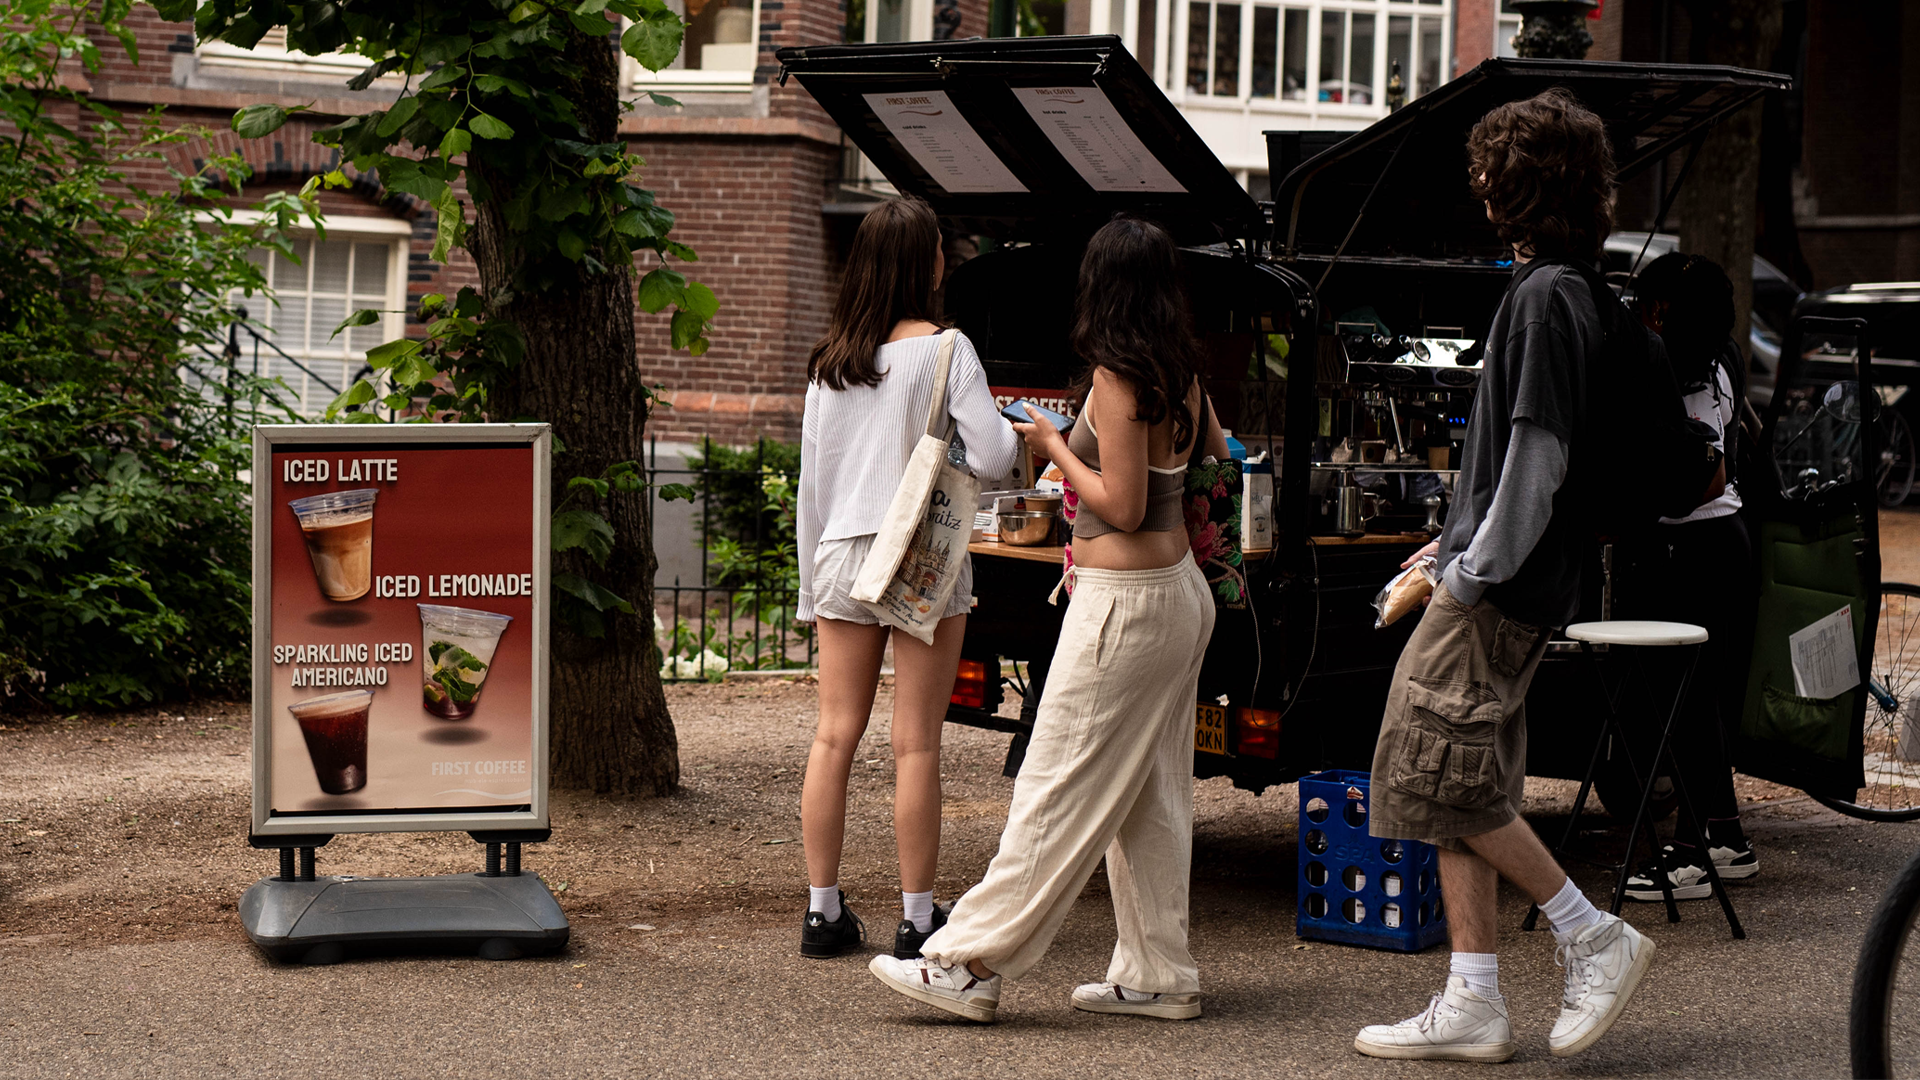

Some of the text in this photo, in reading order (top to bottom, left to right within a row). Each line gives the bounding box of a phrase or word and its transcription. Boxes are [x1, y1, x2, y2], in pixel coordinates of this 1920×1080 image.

[993, 395, 1076, 418] ST FFEE
[284, 458, 398, 482] ICED LATTE
[931, 489, 951, 507] a
[375, 574, 532, 598] ICED LEMONADE
[274, 643, 413, 664] SPARKLING ICED
[291, 667, 387, 687] AMERICANO
[1196, 730, 1222, 750] OKN
[431, 760, 526, 776] FIRST COFFEE
